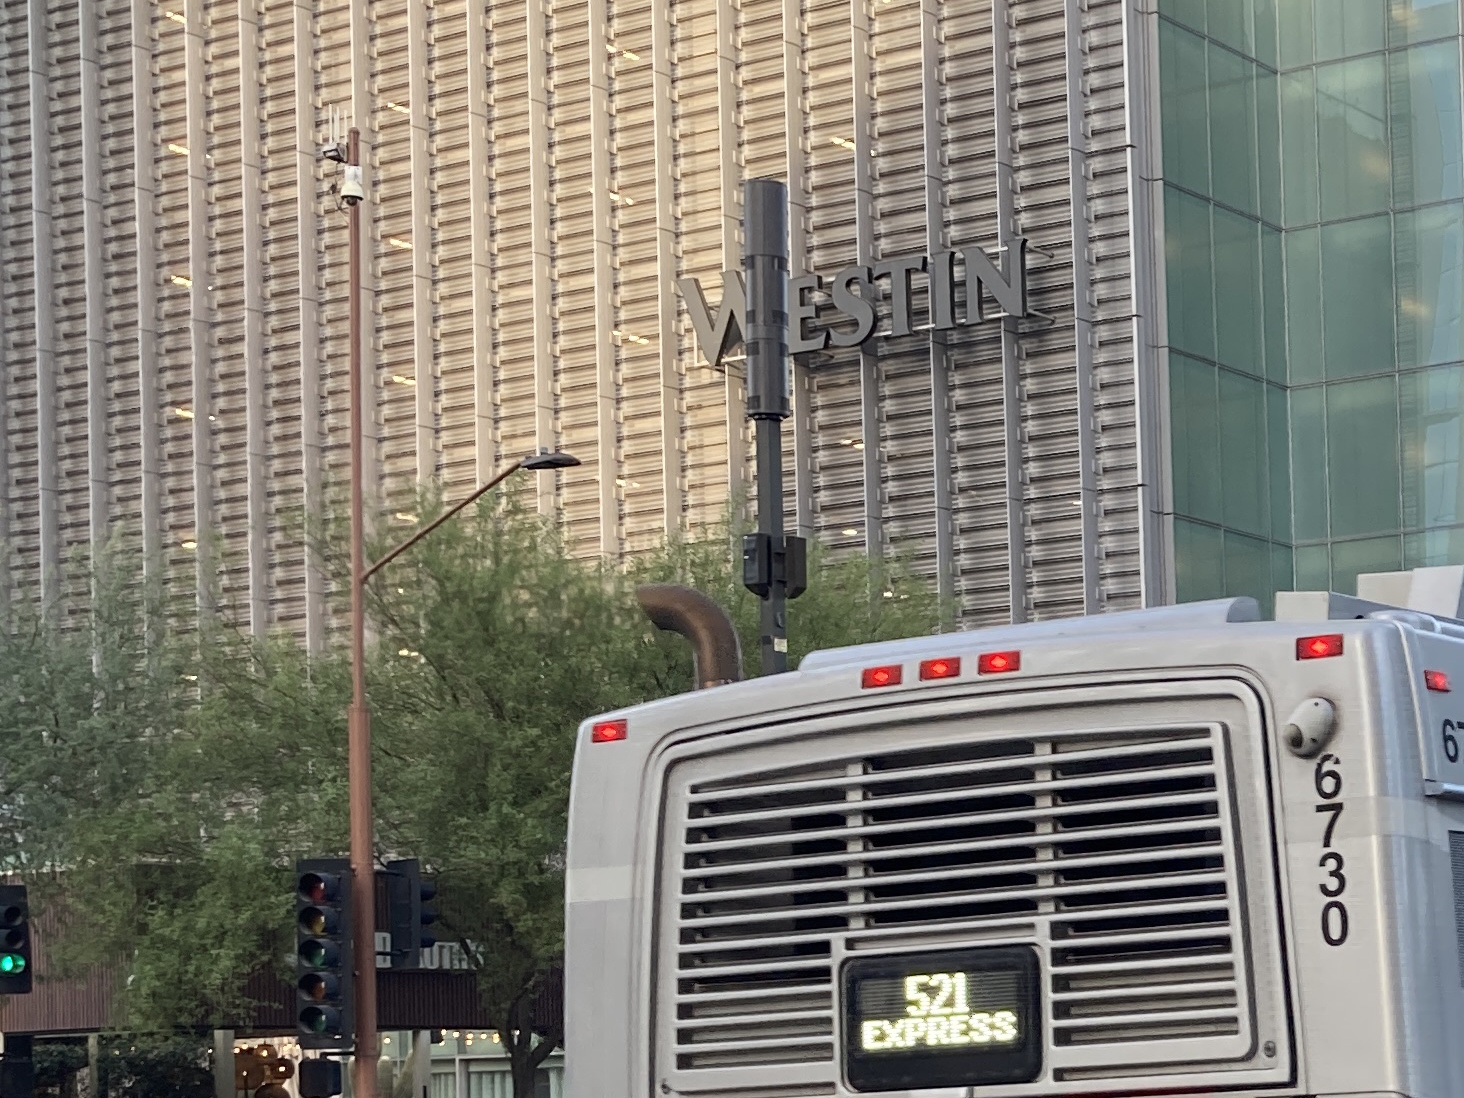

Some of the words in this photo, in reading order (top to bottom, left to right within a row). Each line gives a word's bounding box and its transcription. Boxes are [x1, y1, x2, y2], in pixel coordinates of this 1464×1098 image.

[678, 238, 1029, 366] WESTIN
[1314, 753, 1350, 948] 6730
[861, 1010, 1018, 1051] EXPRESS
[904, 971, 970, 1017] 521
